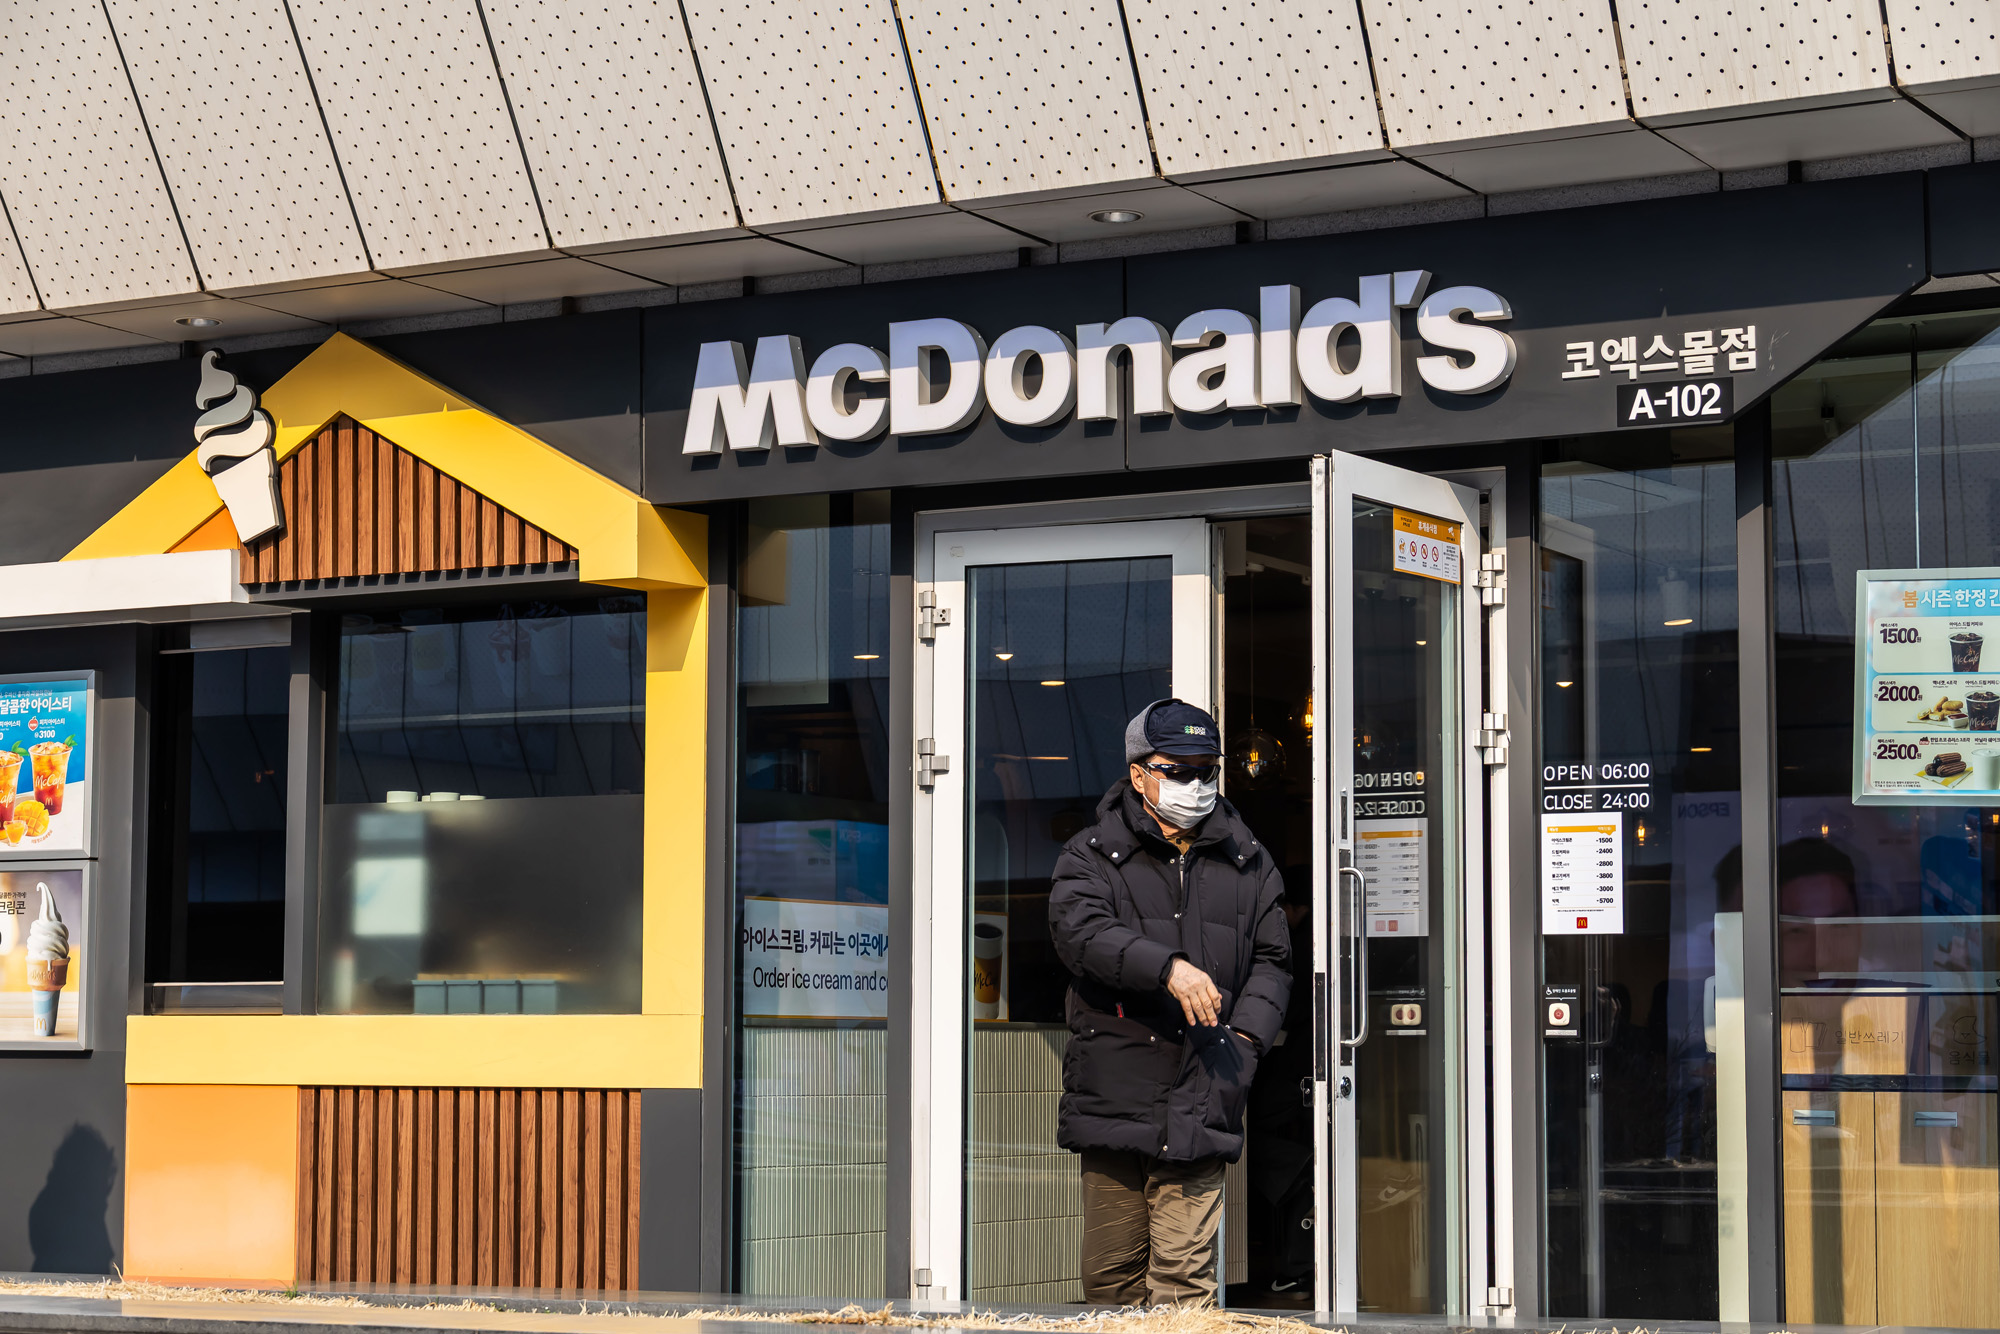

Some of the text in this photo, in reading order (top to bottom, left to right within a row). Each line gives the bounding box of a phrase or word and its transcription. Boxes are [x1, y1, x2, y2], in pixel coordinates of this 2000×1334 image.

[682, 269, 1517, 456] McDonald's
[1561, 325, 1757, 381] 코엑스몰점
[1628, 383, 1722, 420] A-102
[1902, 590, 1919, 608] 봄
[1921, 589, 1952, 608] 시즌
[1954, 589, 1986, 608] 한정
[0, 696, 72, 715] 달콤한 아이스티
[39, 730, 56, 738] 3100
[1543, 763, 1650, 781] OPEN 06:00
[1544, 792, 1650, 810] CLOSE 24:00
[743, 927, 808, 953] 아이스크림,
[810, 930, 846, 955] 커피는
[753, 966, 789, 988] Order
[792, 967, 810, 989] ice
[812, 973, 852, 990] cream
[855, 970, 877, 991] and
[1834, 1030, 1904, 1044] 일반쓰레기
